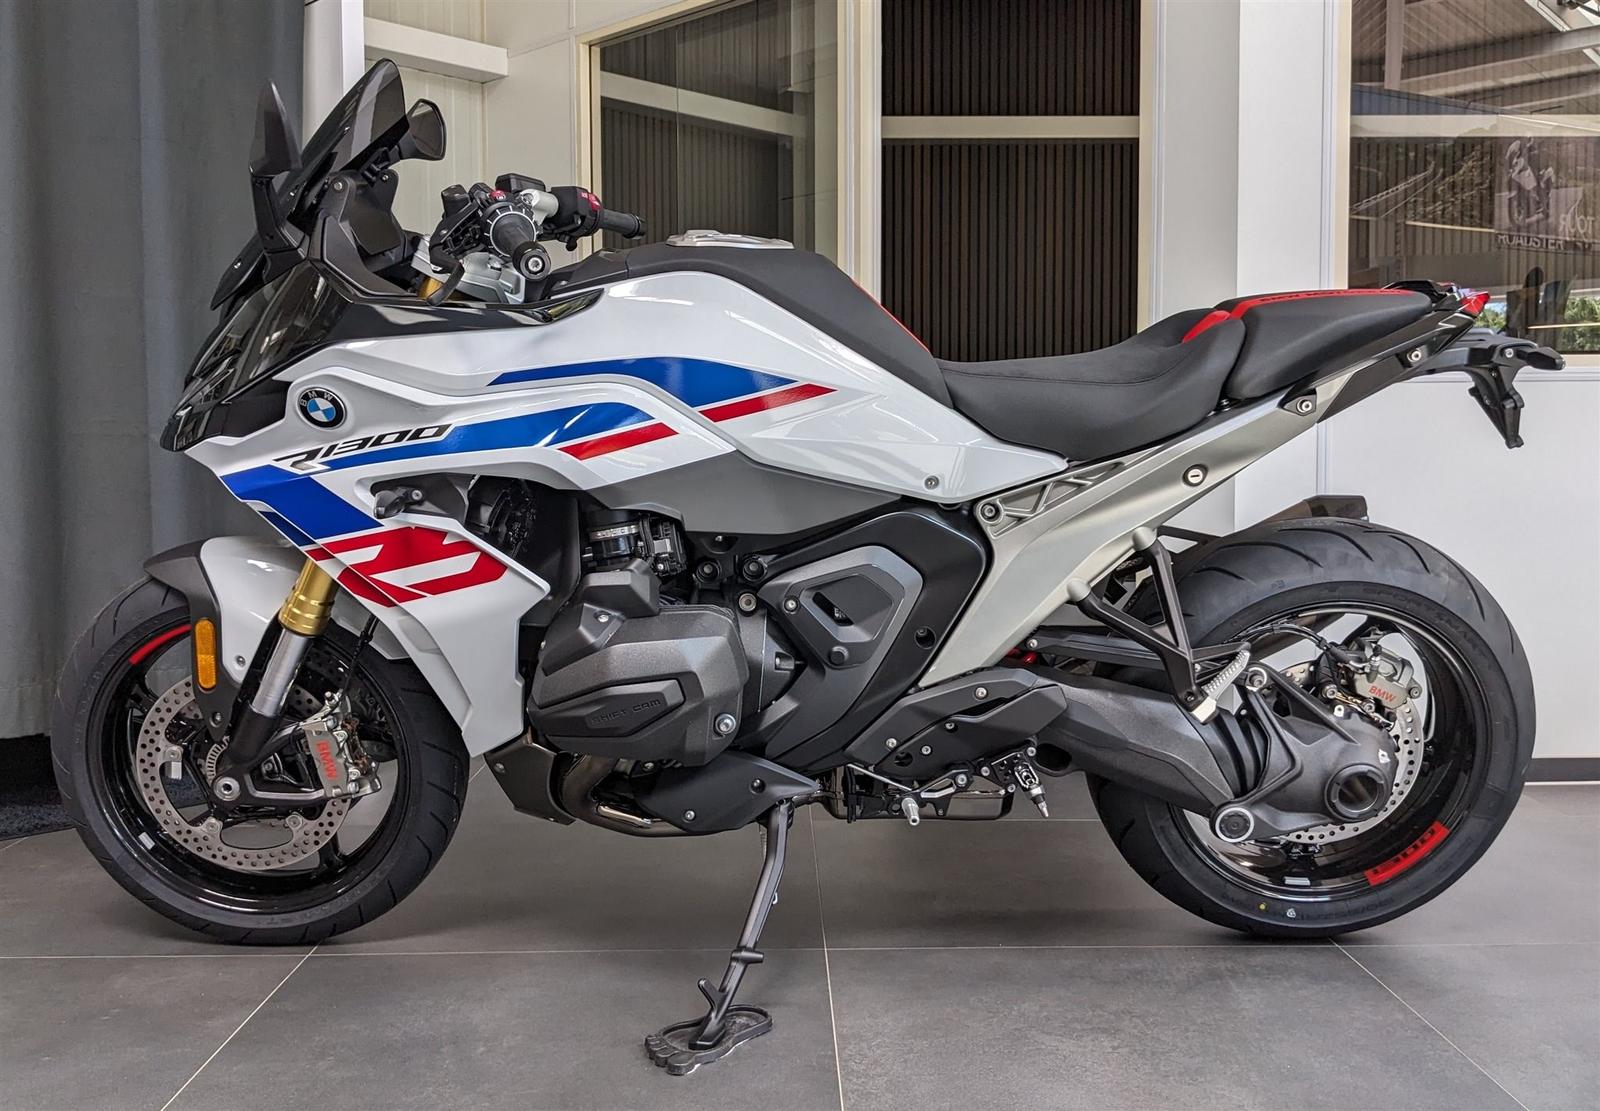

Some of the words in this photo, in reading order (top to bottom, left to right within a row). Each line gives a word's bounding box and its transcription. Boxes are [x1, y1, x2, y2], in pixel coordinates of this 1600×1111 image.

[300, 390, 333, 407] BMW
[1369, 685, 1397, 702] BMW
[316, 740, 337, 779] BMW
